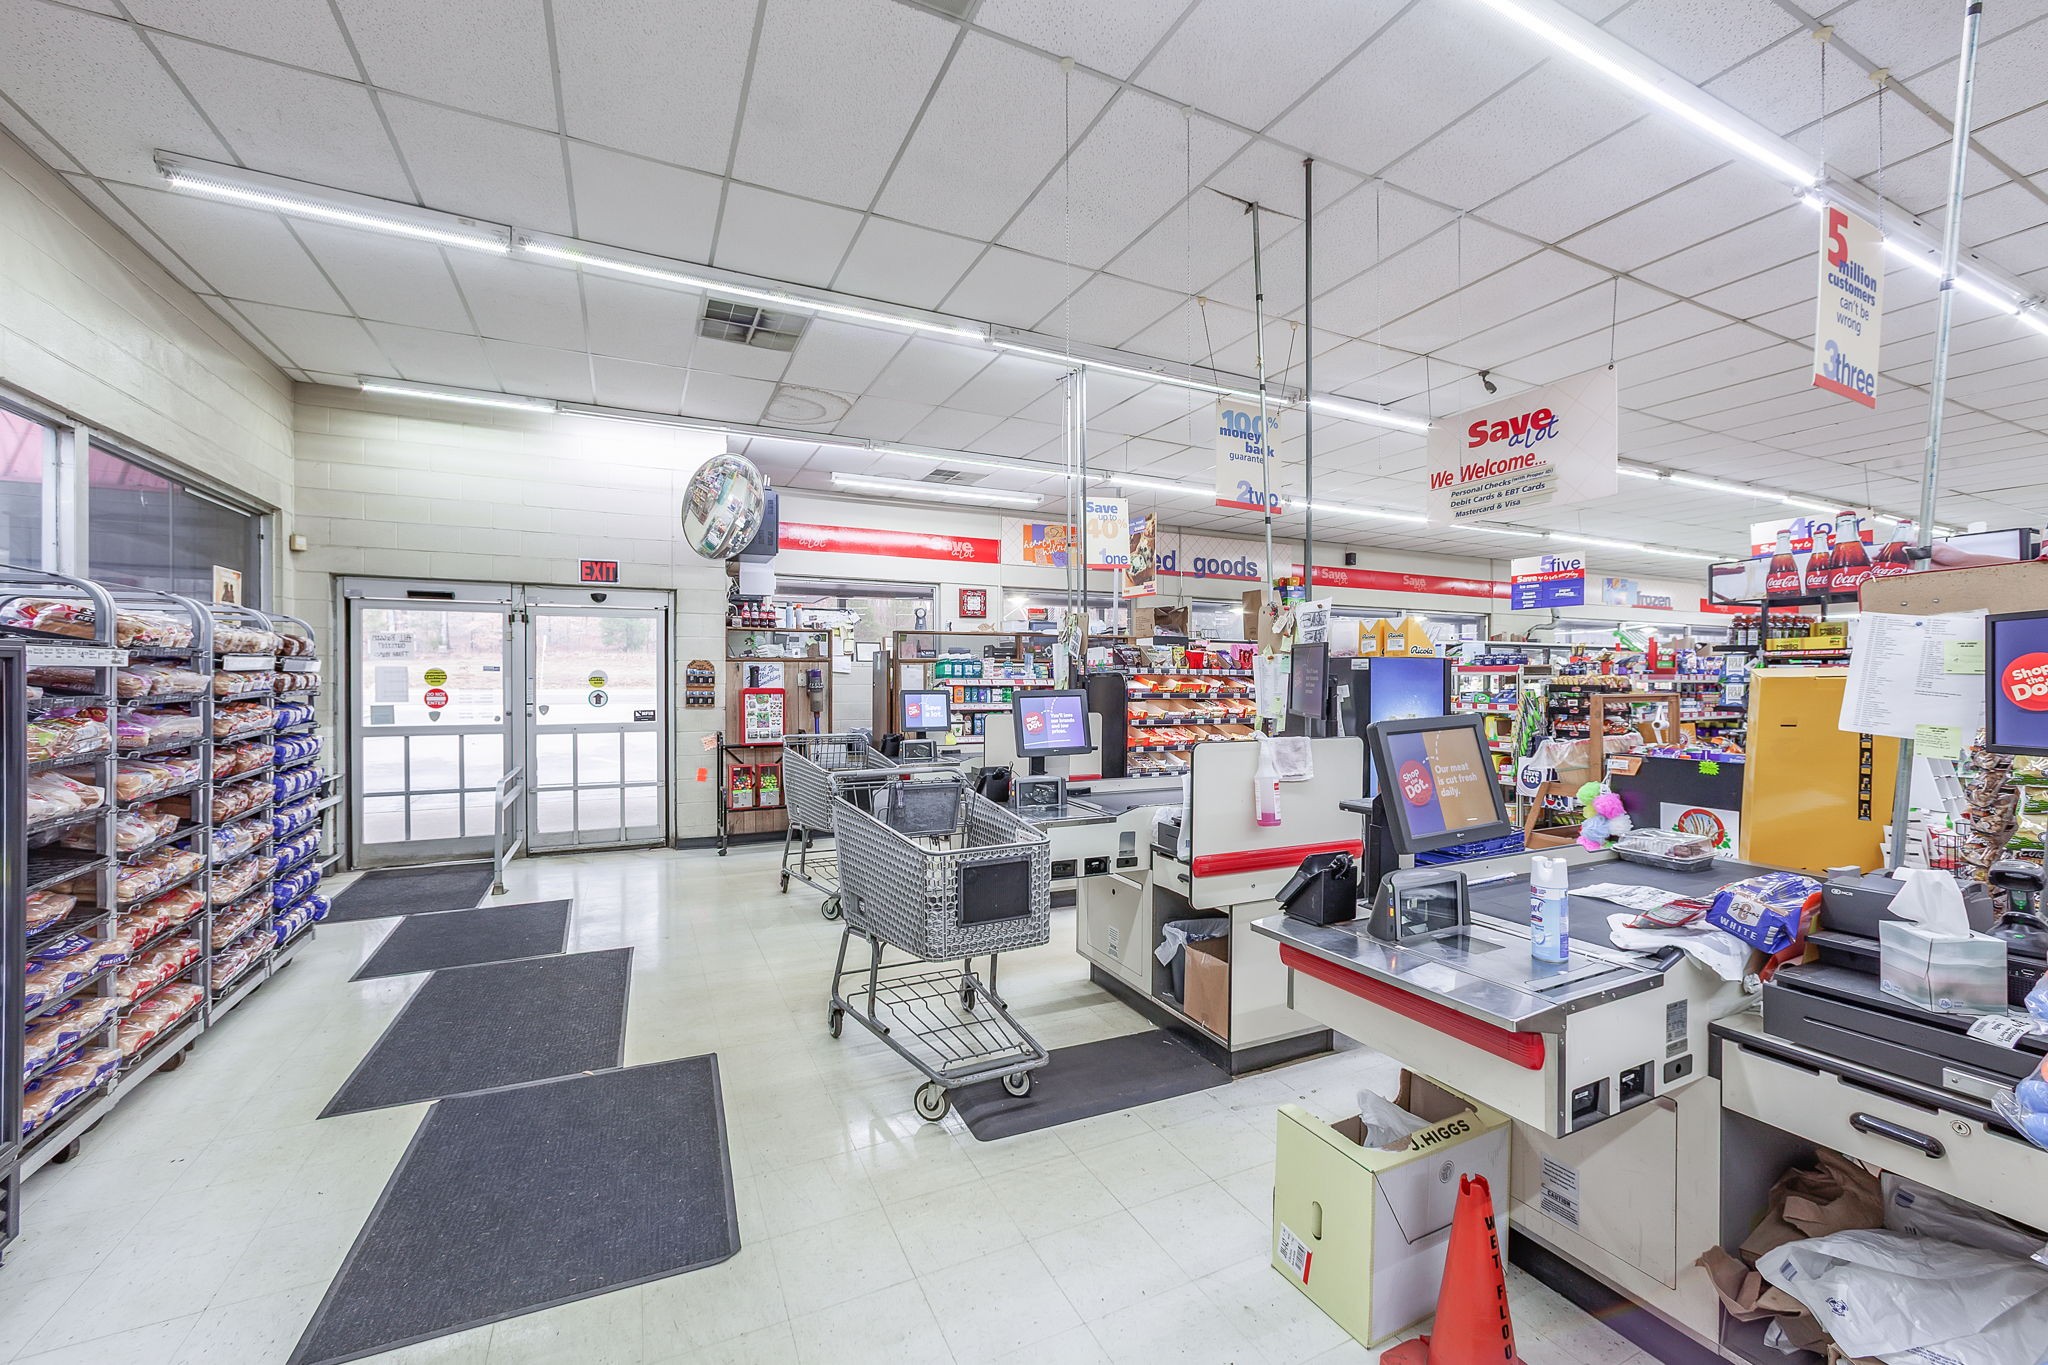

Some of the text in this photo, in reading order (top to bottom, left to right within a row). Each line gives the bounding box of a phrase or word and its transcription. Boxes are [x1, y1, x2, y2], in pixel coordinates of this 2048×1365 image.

[1828, 207, 1848, 267] 5
[1839, 259, 1877, 292] million
[1828, 272, 1876, 307] customers
[1840, 296, 1869, 320] can't be
[1837, 311, 1861, 337] wrong
[1823, 339, 1875, 397] 3 three
[1219, 426, 1262, 444] money
[1468, 408, 1553, 448] Save
[1229, 452, 1264, 464] guarante
[1430, 470, 1454, 490] We
[1450, 484, 1483, 498] Personal
[1484, 478, 1511, 490] Checks
[1236, 480, 1252, 504] 2
[1450, 497, 1472, 508] Debit
[1473, 493, 1495, 504] Cards
[1505, 487, 1520, 497] EBT
[1522, 482, 1545, 494] Cards
[1086, 502, 1118, 514] Save
[1455, 503, 1495, 518] Mastercard
[1505, 499, 1521, 508] Visa
[1089, 518, 1127, 540] 40%
[1805, 517, 1865, 538] for
[1106, 554, 1128, 565] one
[1193, 556, 1258, 578] goods
[1551, 558, 1581, 572] five
[582, 561, 616, 581] EXIT
[1322, 568, 1347, 580] Save
[1403, 575, 1427, 586] Save
[1637, 591, 1671, 607] frozen
[1410, 646, 1433, 655] Ricola
[2012, 664, 2048, 681] Shop
[2028, 676, 2044, 686] the
[1403, 769, 1420, 782] Shop
[1435, 762, 1469, 774] Our meat
[1405, 779, 1429, 799] Dot.
[1446, 776, 1458, 785] cut
[1459, 773, 1478, 783] fresh
[1441, 786, 1461, 797] daily.
[1720, 916, 1758, 940] WHITE
[1411, 1119, 1470, 1151] J.HIGGS
[1485, 1216, 1499, 1269] WET
